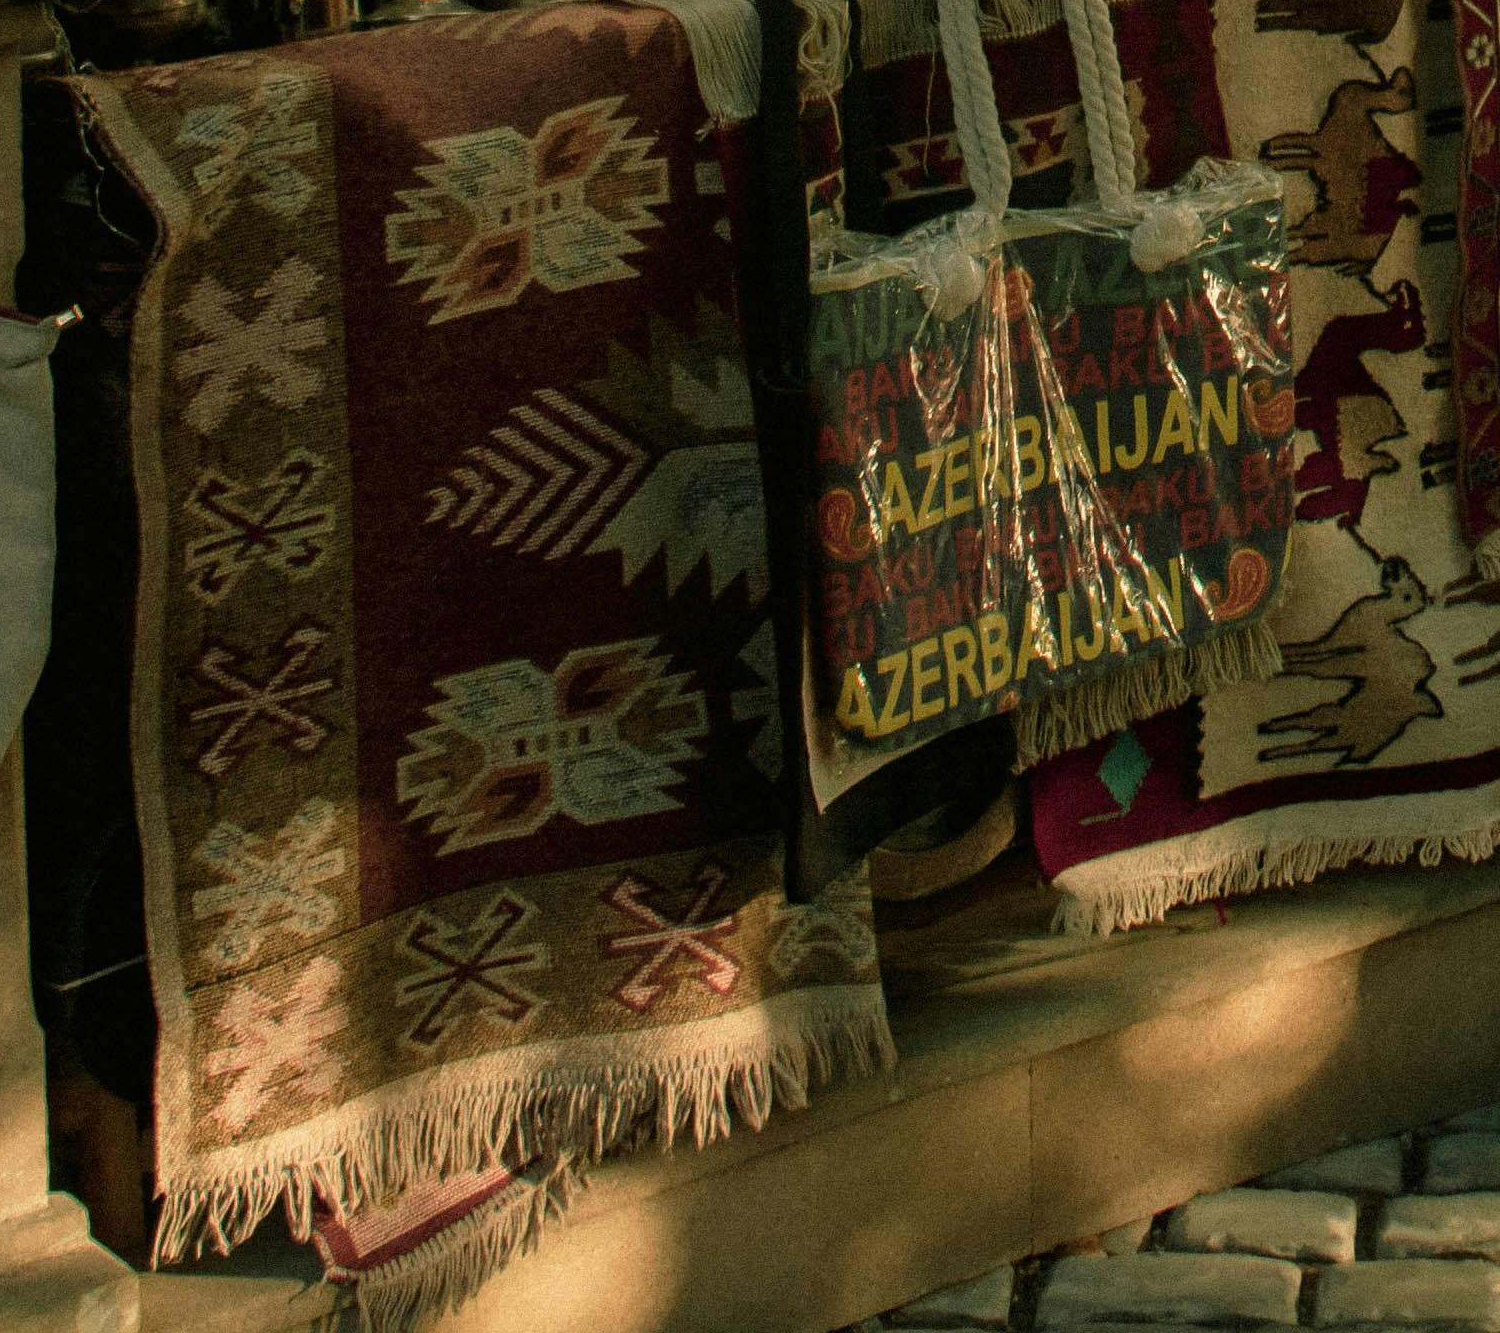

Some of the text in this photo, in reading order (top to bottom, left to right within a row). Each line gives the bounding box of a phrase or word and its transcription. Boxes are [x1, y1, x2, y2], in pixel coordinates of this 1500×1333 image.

[1111, 288, 1235, 351] BAK
[879, 375, 1239, 543] AZERBAIJAN
[823, 543, 934, 619] BAKU
[835, 557, 1187, 737] AZERBAIJAN
